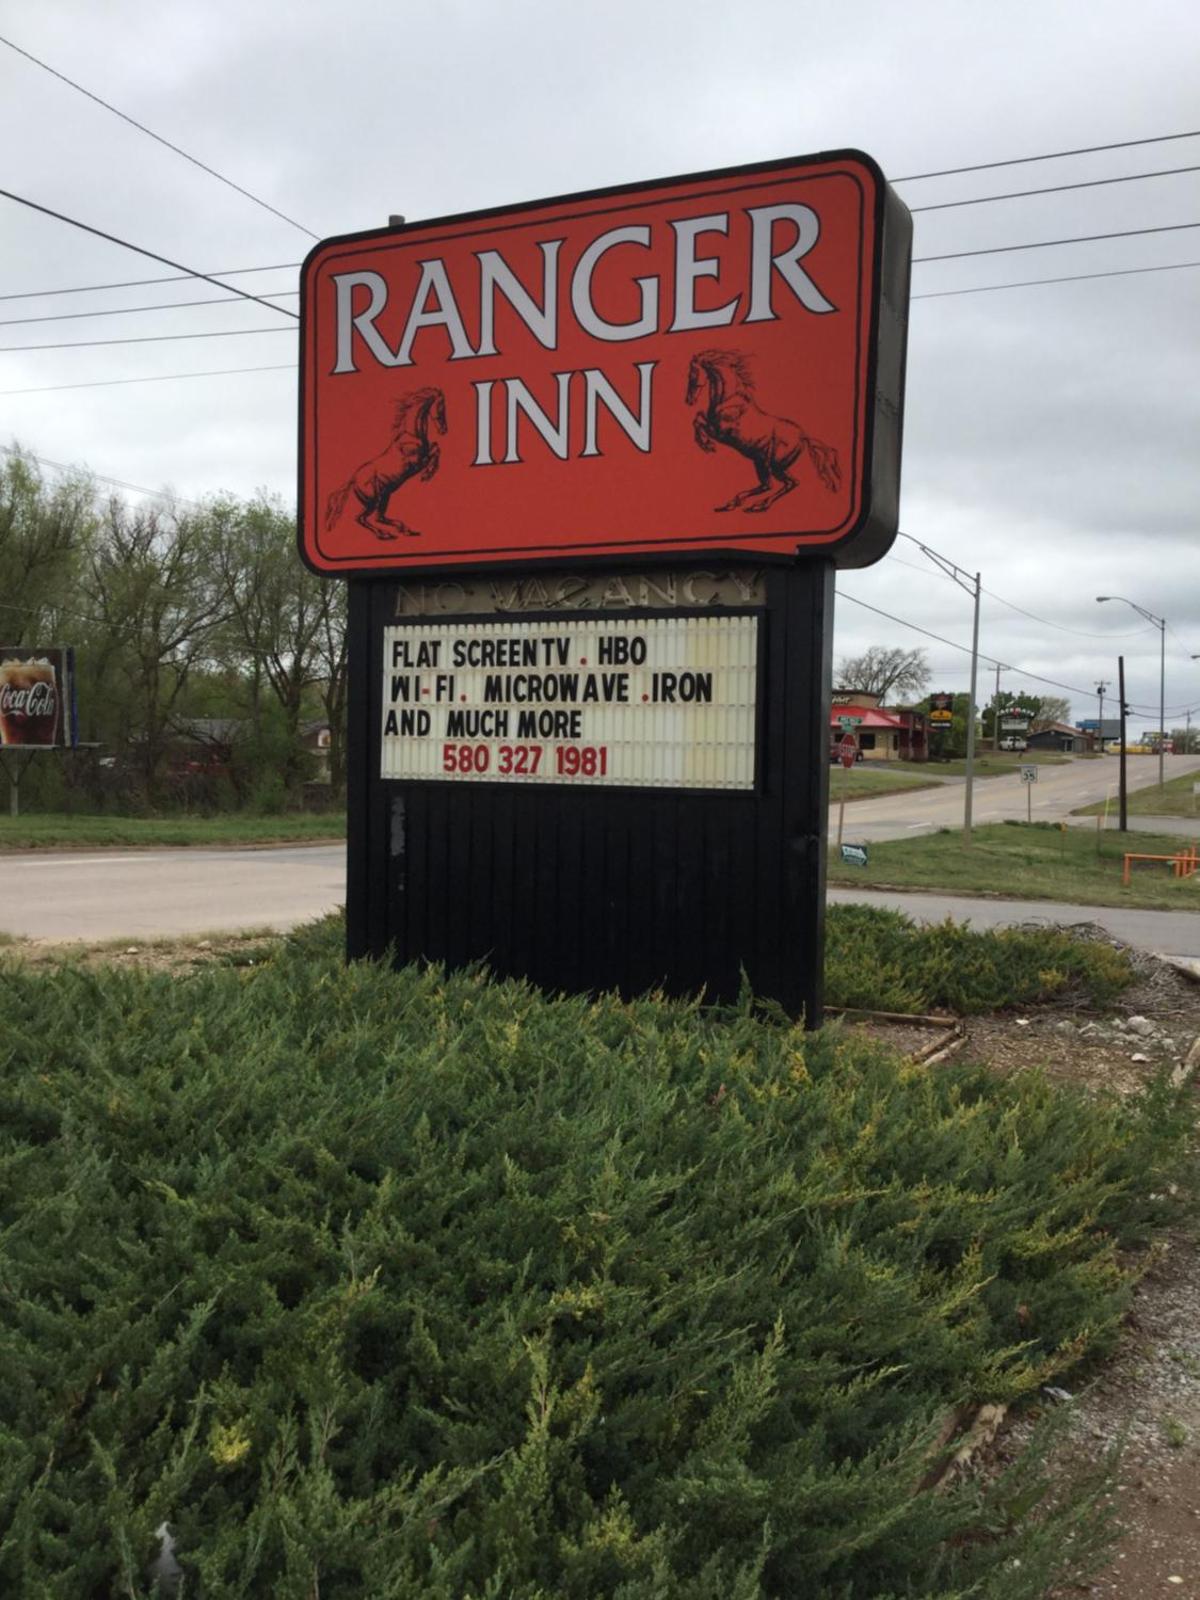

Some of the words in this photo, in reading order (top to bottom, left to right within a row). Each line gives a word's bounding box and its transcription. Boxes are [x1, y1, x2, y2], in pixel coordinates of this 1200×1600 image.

[329, 203, 837, 375] RANGER
[471, 360, 659, 466] INN
[490, 571, 764, 609] VACANCY
[392, 640, 441, 668] FLAT
[598, 636, 647, 665] HBO
[0, 681, 55, 717] Coca-Cola
[484, 672, 629, 703] MICROWAVE
[384, 710, 431, 737] AND
[446, 710, 508, 738] MUCH
[517, 710, 582, 739] MORE
[442, 744, 490, 773] 580
[498, 746, 544, 774] 327
[556, 746, 608, 776] 1981
